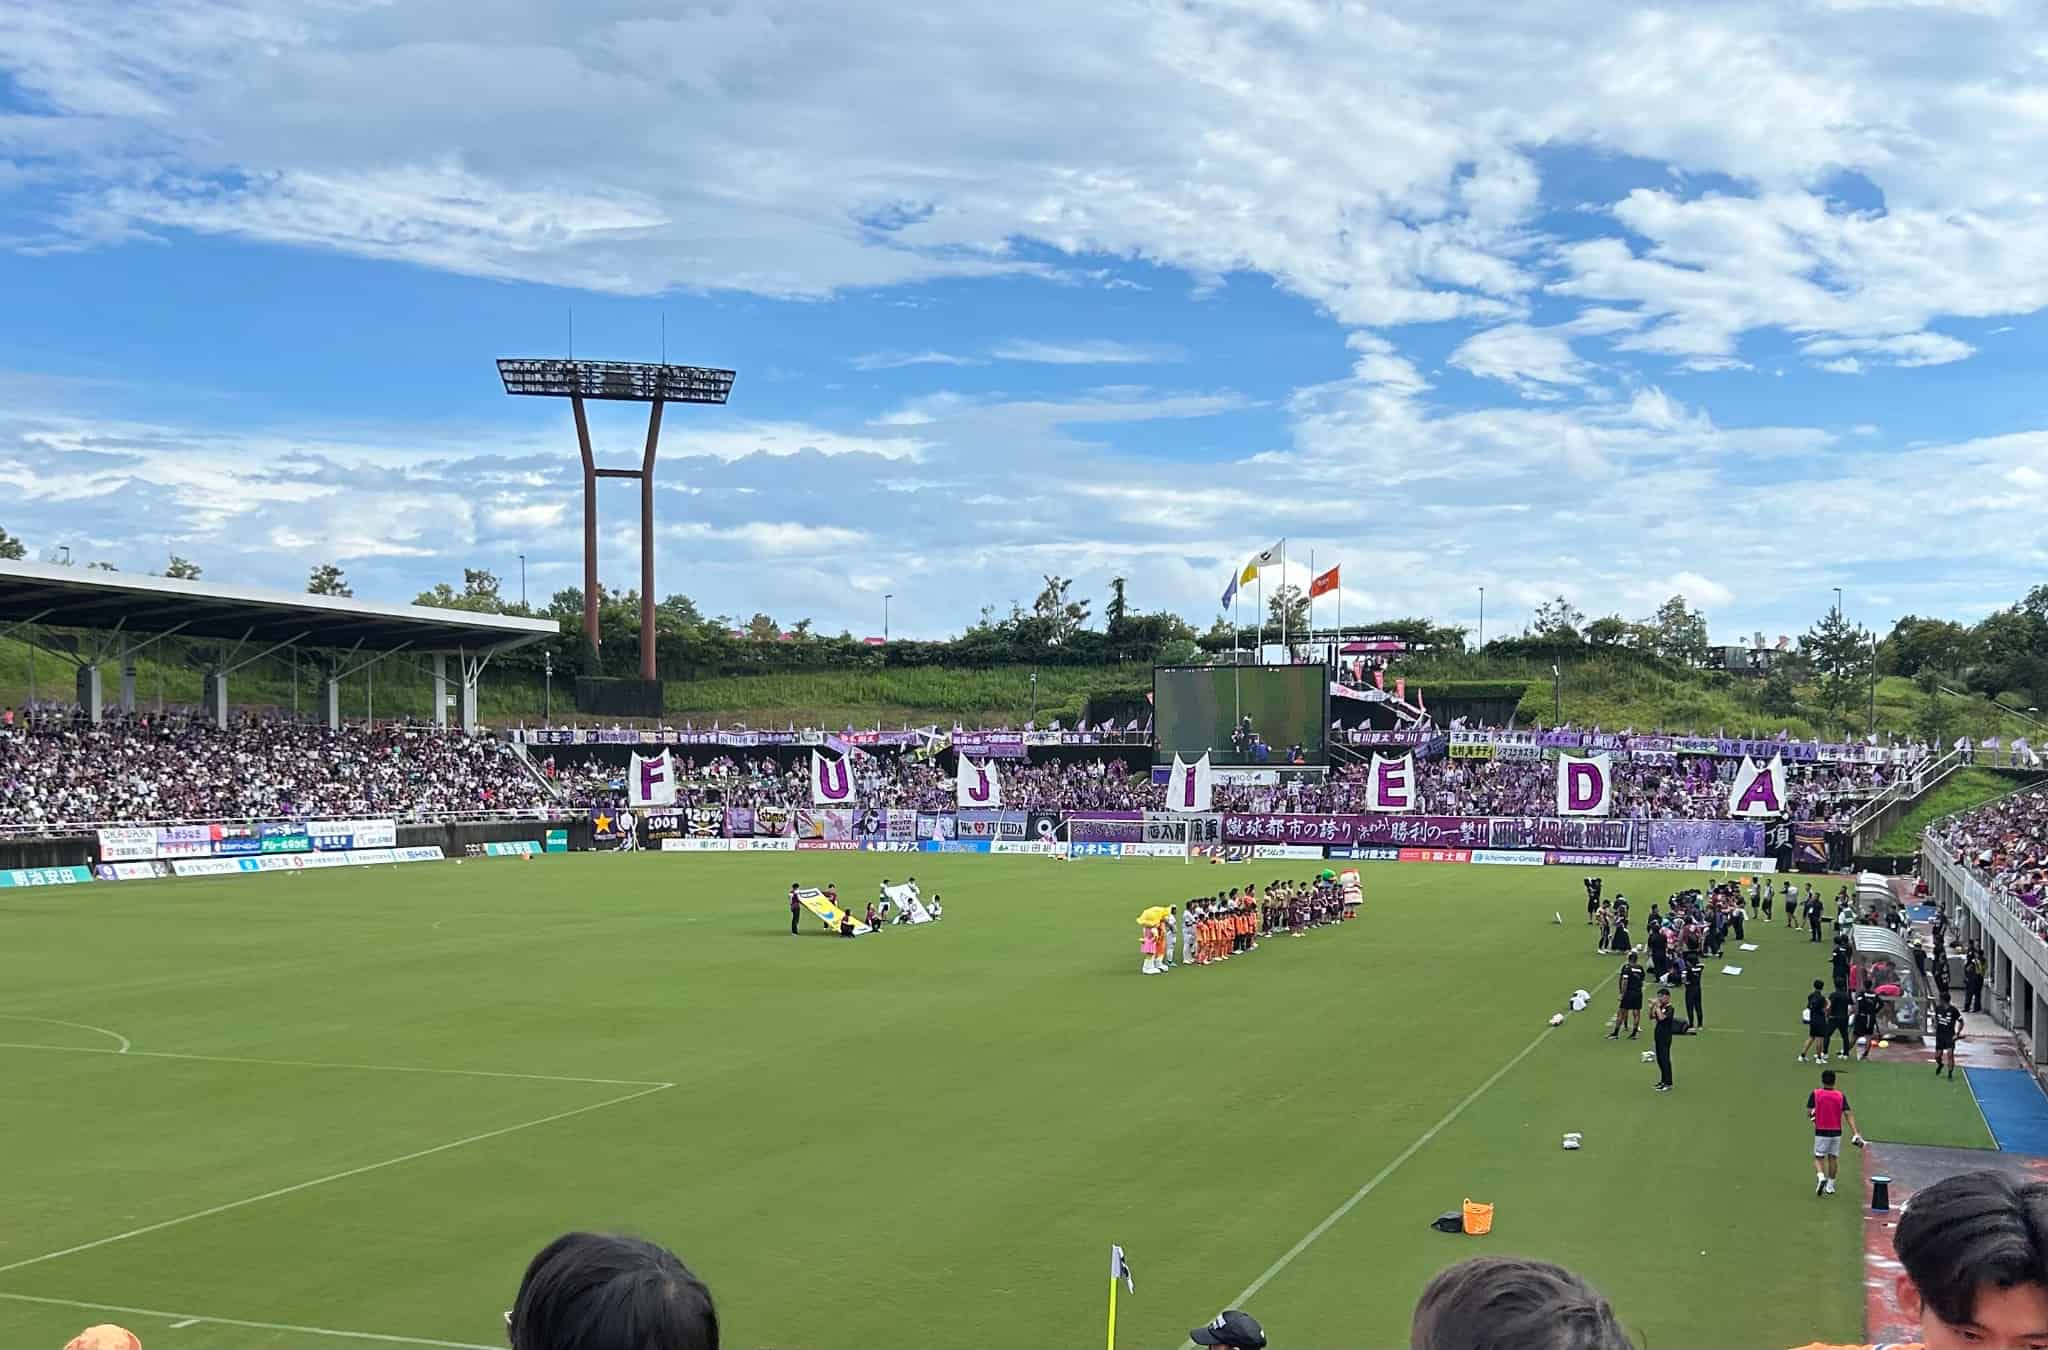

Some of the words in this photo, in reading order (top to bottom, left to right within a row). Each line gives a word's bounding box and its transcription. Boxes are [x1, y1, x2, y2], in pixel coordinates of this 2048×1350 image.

[640, 757, 665, 801] F
[819, 758, 850, 800] U
[968, 767, 990, 801] J
[1184, 766, 1196, 808] I
[1378, 762, 1408, 807] E
[1567, 762, 1605, 811] D
[1736, 768, 1780, 812] A
[685, 807, 723, 822] 120%
[648, 816, 679, 830] 2009
[960, 821, 972, 834] We
[1226, 816, 1351, 841] 蹴球都市の誇り
[1766, 820, 1793, 849] 頂
[829, 841, 860, 850] PATON
[876, 841, 920, 853] 東海ガス
